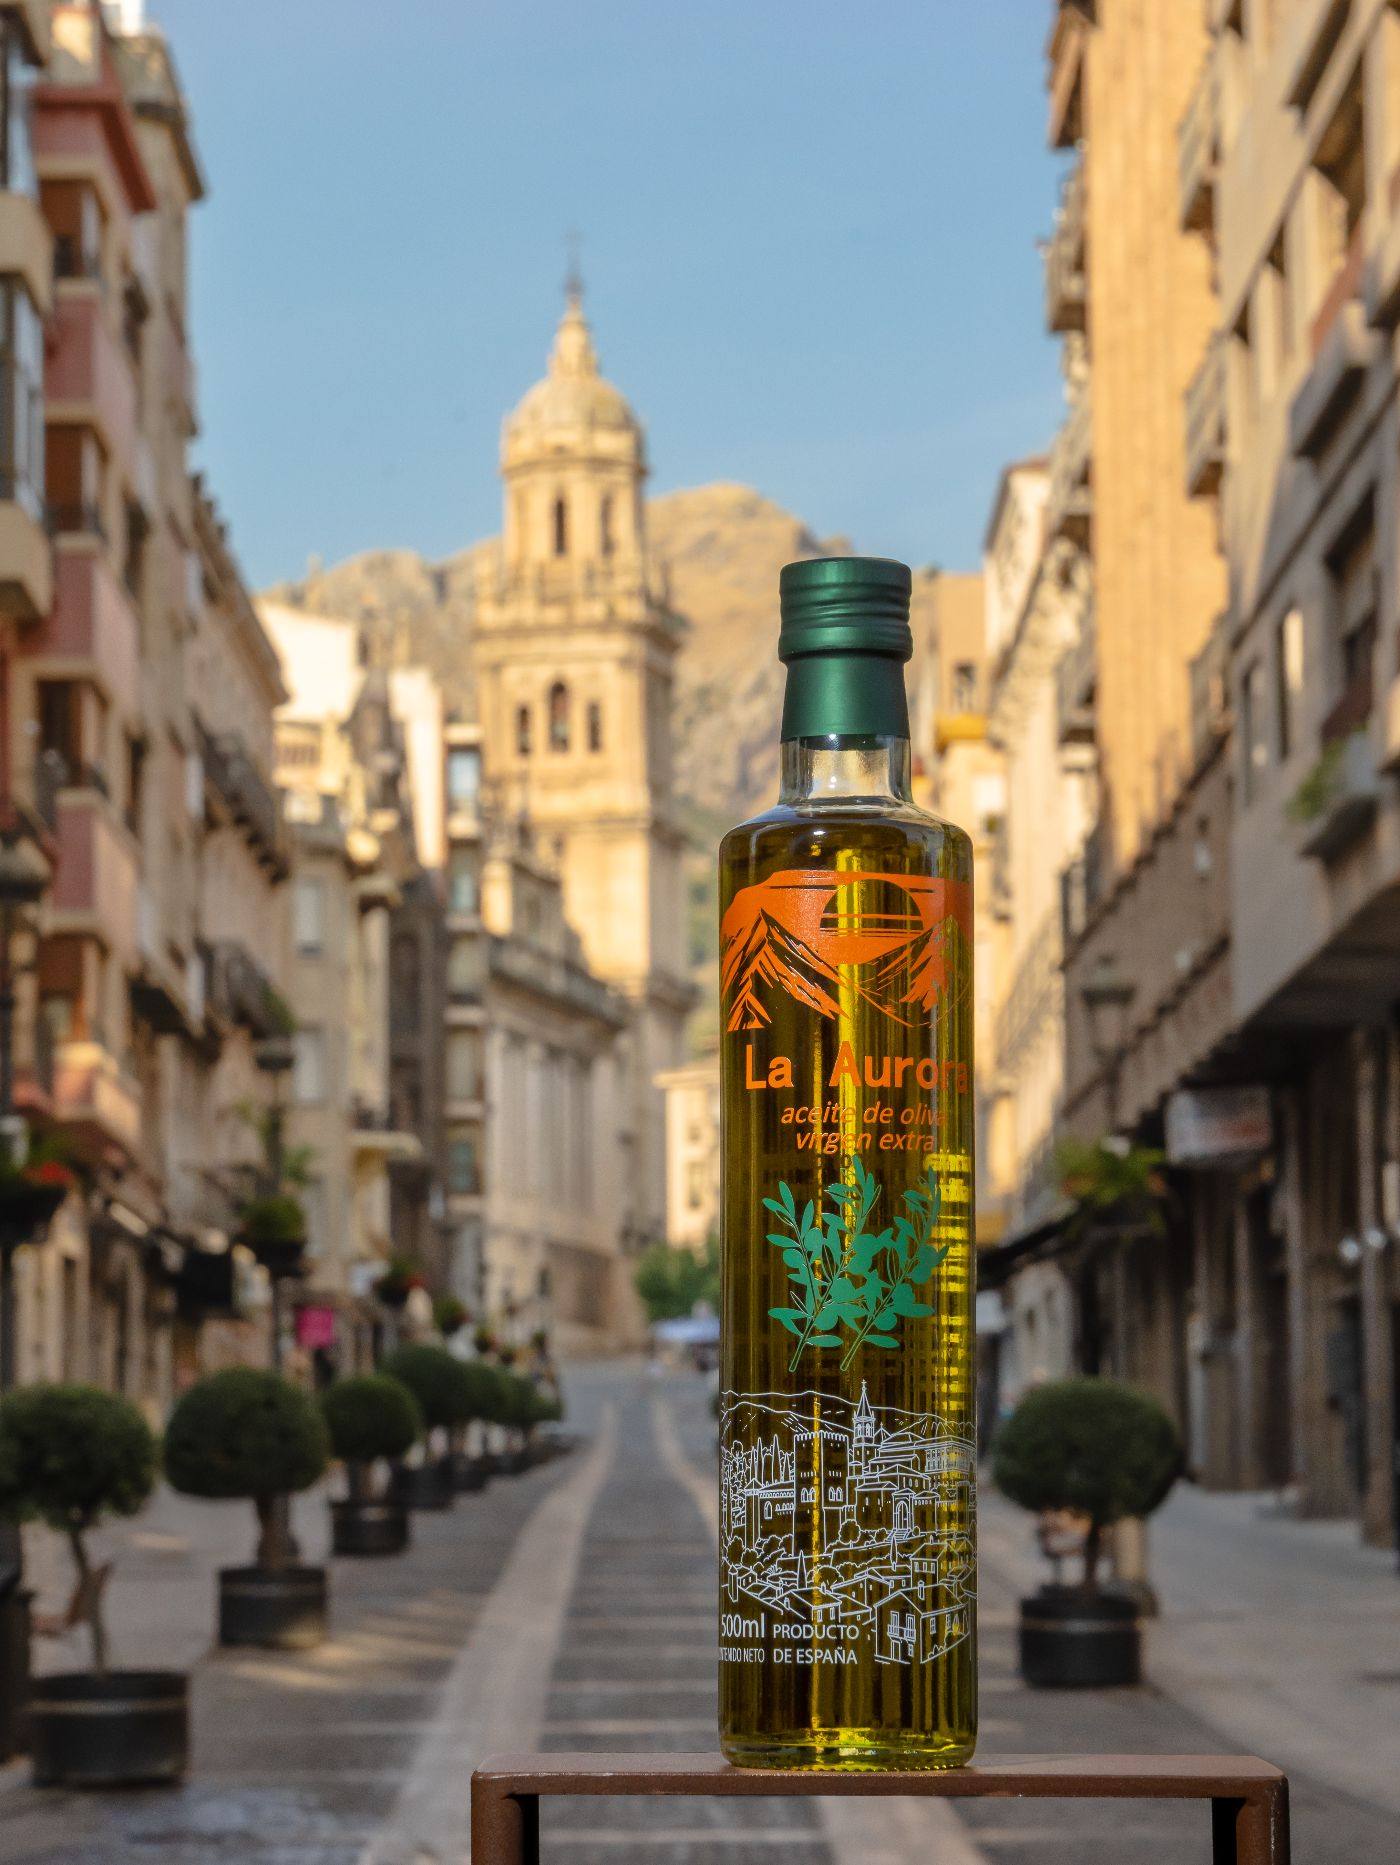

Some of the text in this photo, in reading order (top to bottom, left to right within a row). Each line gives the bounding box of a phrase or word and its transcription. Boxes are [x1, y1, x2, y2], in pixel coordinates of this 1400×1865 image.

[745, 1040, 968, 1095] La Aurora
[780, 1101, 947, 1126] aceite de oliva
[796, 1131, 935, 1154] virgen extra
[721, 1612, 765, 1638] 500ml
[773, 1624, 860, 1640] PRODUCTO
[743, 1648, 765, 1663] NETO
[773, 1646, 858, 1665] DE ESPAÑA
